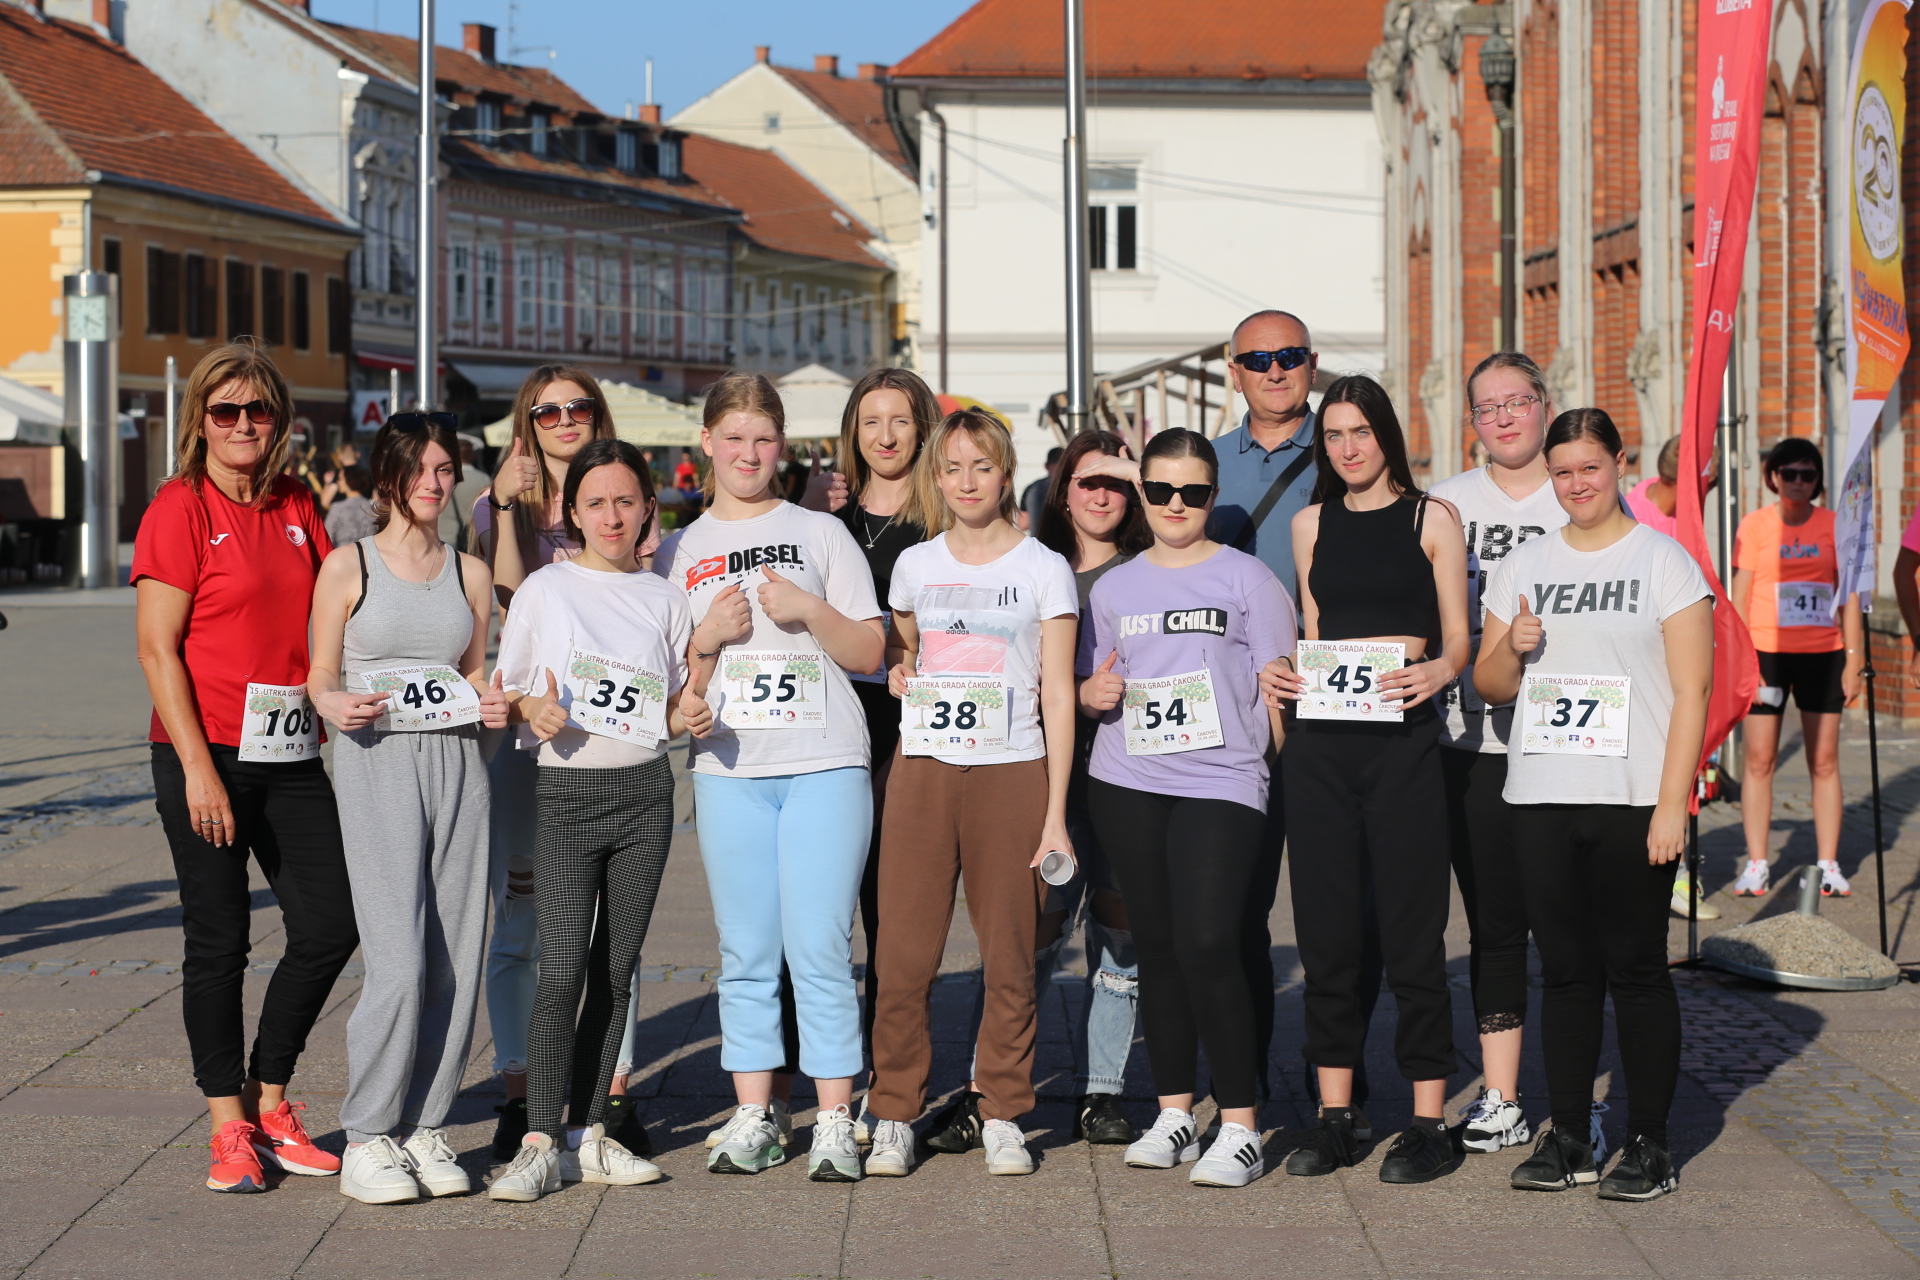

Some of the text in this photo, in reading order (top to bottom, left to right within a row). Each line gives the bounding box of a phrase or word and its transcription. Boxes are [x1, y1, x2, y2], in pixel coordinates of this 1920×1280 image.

[729, 544, 804, 575] DIESEL
[1534, 579, 1640, 615] YEAH!
[1794, 595, 1818, 611] 41
[1119, 610, 1225, 639] JUST CHILL.
[725, 654, 735, 662] 15.
[788, 653, 820, 662] ČAKOVCA
[1313, 644, 1337, 652] UTRKA
[1339, 645, 1364, 653] GRADA
[1366, 644, 1400, 654] ČAKOVCA
[375, 670, 398, 679] UTRKA
[586, 654, 610, 667] UTRKA
[611, 661, 636, 674] GRADA
[637, 667, 665, 683] ČAKOVCA
[1147, 681, 1171, 690] GRADA
[1172, 674, 1206, 686] ČAKOVCA
[1327, 665, 1373, 694] 45
[1539, 678, 1563, 686] UTRKA
[1563, 678, 1588, 686] GRADA
[1590, 678, 1625, 688] ČAKOVCA
[250, 687, 261, 695] 15.
[263, 689, 287, 697] UTRKA
[403, 678, 446, 709] 46
[590, 679, 641, 714] 35
[751, 674, 797, 703] 55
[917, 681, 940, 689] UTRKA
[941, 681, 966, 689] GRADA
[967, 680, 1002, 689] ČAKOVCA
[266, 705, 312, 737] 108
[457, 705, 478, 714] ČAKOVEC
[930, 701, 977, 730] 38
[1145, 698, 1187, 730] 54
[1550, 698, 1600, 728] 37
[1196, 729, 1218, 737] ČAKOVEC
